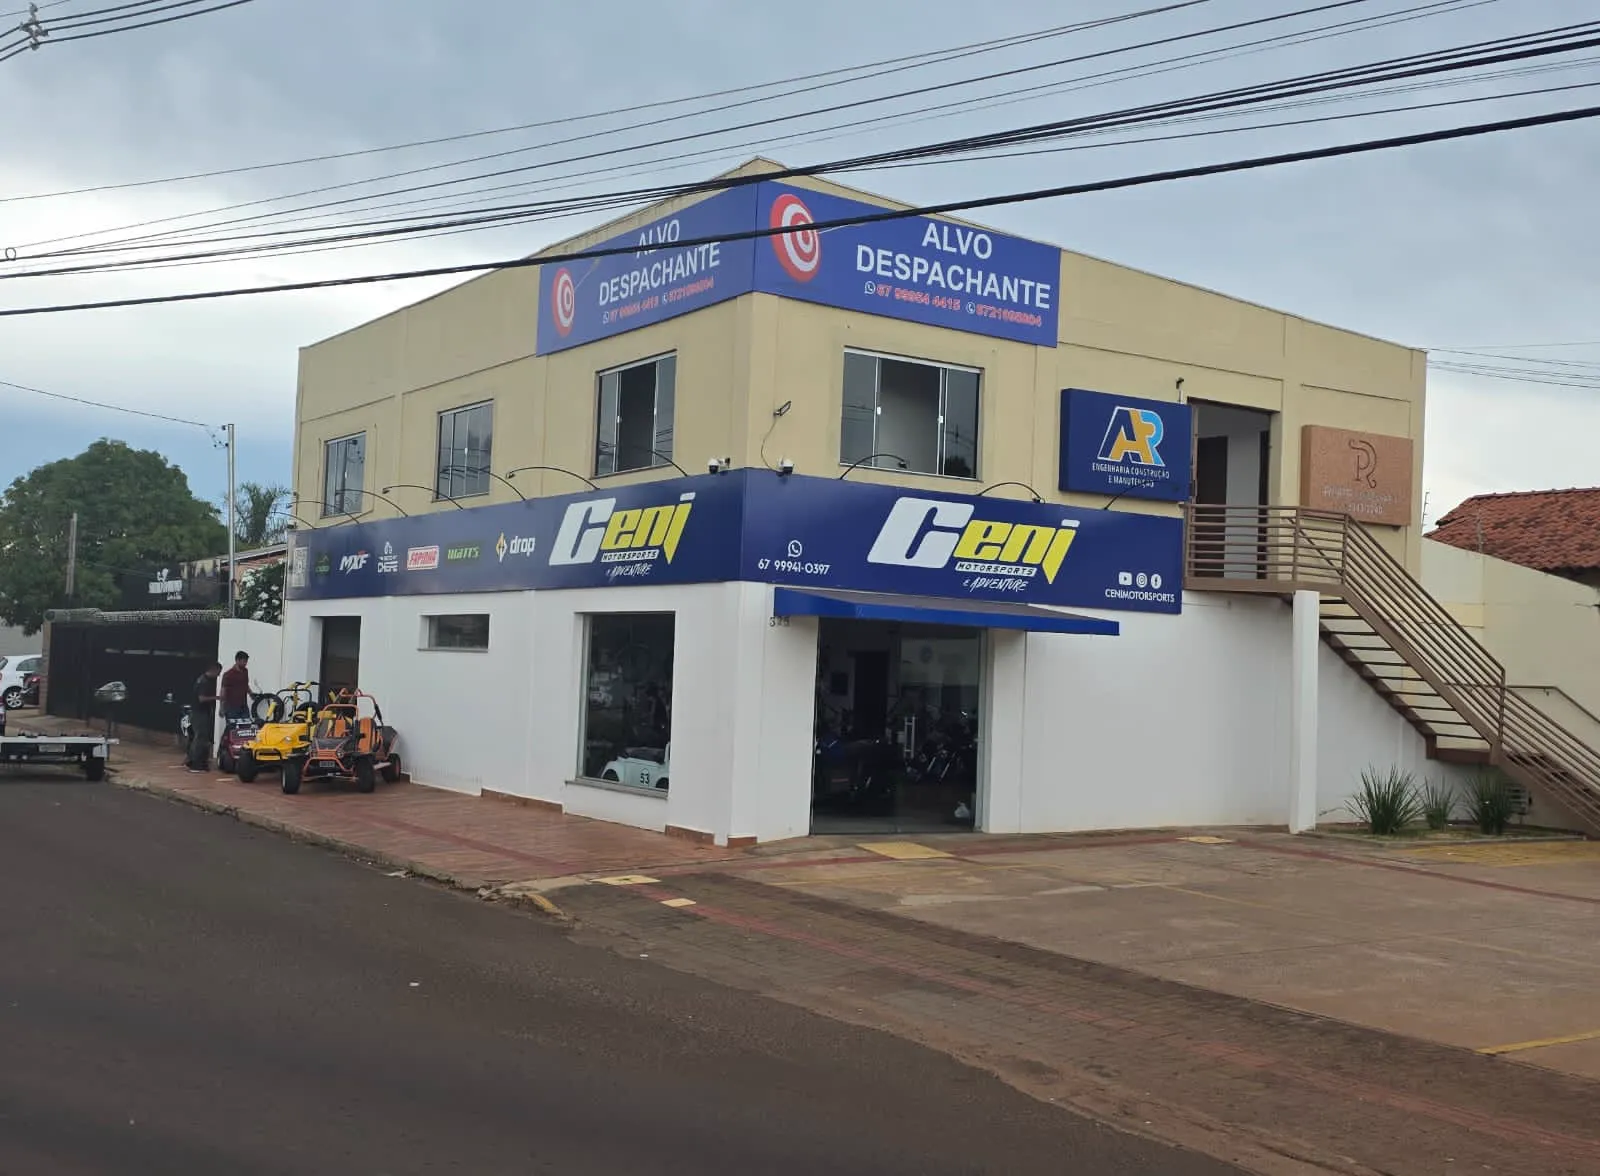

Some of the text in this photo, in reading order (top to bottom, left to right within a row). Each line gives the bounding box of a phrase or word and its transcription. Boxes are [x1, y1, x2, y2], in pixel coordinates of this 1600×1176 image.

[637, 219, 680, 258] ALVO
[922, 222, 993, 260] ALVO
[599, 242, 721, 306] DESPACHANTE
[856, 244, 1051, 309] DESPACHANTE
[1097, 406, 1166, 468] AR
[1092, 462, 1130, 475] ENGENHARIA
[509, 535, 536, 557] drop
[602, 550, 658, 561] MOTORSPORTS
[339, 553, 370, 575] MXF
[758, 558, 831, 575] 67 99941-0397
[957, 562, 1035, 576] MOTORSPORTS
[969, 576, 1030, 593] ADVENTURE
[1105, 588, 1175, 603] CENIMOTORSPORTS
[640, 772, 650, 785] 53
